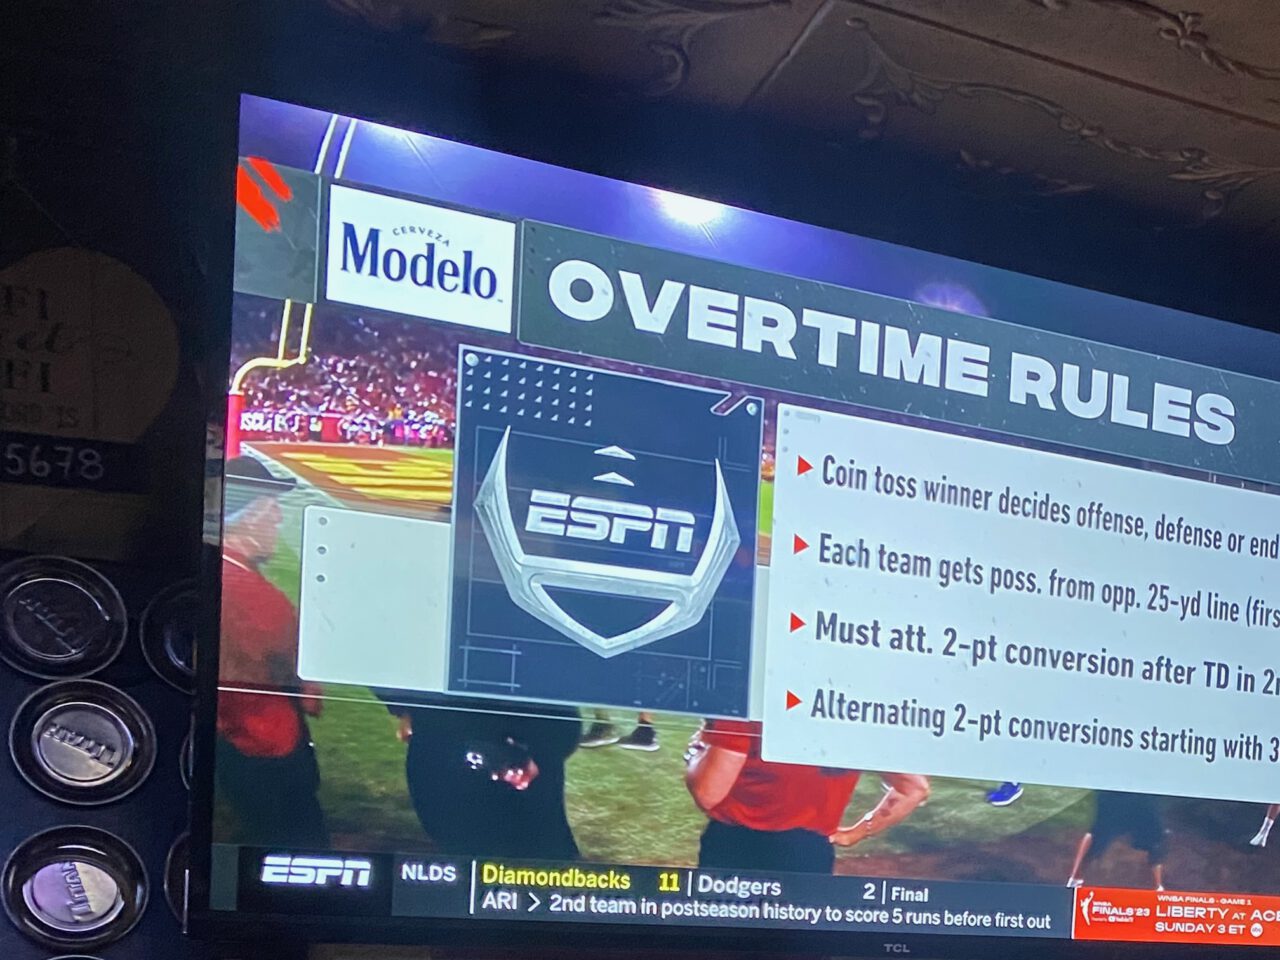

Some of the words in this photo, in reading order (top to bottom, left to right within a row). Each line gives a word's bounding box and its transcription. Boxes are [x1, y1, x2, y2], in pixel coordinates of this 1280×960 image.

[392, 225, 450, 248] CERVEZA
[341, 221, 497, 299] Modelo
[548, 259, 990, 397] OVERTIME
[1009, 352, 1236, 445] RULES
[525, 488, 695, 553] ESPN
[822, 455, 867, 490] Coin
[875, 466, 917, 498] toss
[924, 475, 993, 511] winner
[999, 486, 1071, 524] decides
[1077, 501, 1148, 541] offense,
[1155, 514, 1222, 550] defense
[1228, 532, 1245, 553] or
[1250, 534, 1279, 559] end
[819, 533, 870, 568] Each
[879, 544, 931, 578] team
[939, 557, 983, 587] gets
[990, 566, 1042, 594] poss.
[1049, 568, 1094, 600] from
[1102, 583, 1140, 613] opp.
[1147, 583, 1200, 621] 25-yd
[1207, 592, 1239, 622] line
[815, 611, 881, 648] Must
[889, 624, 933, 654] att.
[942, 627, 997, 666] 2-pt
[1005, 641, 1134, 678] conversion
[1142, 655, 1196, 685] after
[1204, 661, 1229, 689] TD
[1236, 665, 1255, 693] in
[811, 689, 945, 737] Alternating
[953, 703, 1001, 741] 2-pt
[1008, 715, 1133, 748] conversions
[1140, 726, 1216, 763] starting
[1224, 734, 1262, 760] with
[260, 855, 371, 887] ESPN
[401, 863, 457, 883] NLDS
[482, 863, 630, 889] Diamondbacks
[658, 872, 680, 892] 11
[698, 874, 782, 898] Dodgers
[863, 883, 876, 900] 2
[891, 886, 929, 903] Final
[482, 892, 518, 910] ARI
[549, 893, 585, 914] 2nd
[590, 896, 636, 914] team
[641, 898, 656, 915] in
[661, 902, 759, 921] postseason
[763, 903, 821, 925] history
[825, 906, 842, 922] to
[845, 909, 888, 923] score
[893, 908, 903, 924] 5
[906, 911, 941, 925] runs
[944, 910, 992, 927] before
[995, 911, 1023, 928] first
[1027, 914, 1051, 930] out
[1156, 905, 1229, 919] LIBERTY
[1232, 912, 1246, 920] AT
[1185, 896, 1214, 904] FINALS
[883, 943, 910, 953] TCL
[1155, 922, 1215, 933] SUNDAY
[1217, 924, 1226, 934] 3
[1228, 925, 1246, 934] ET
